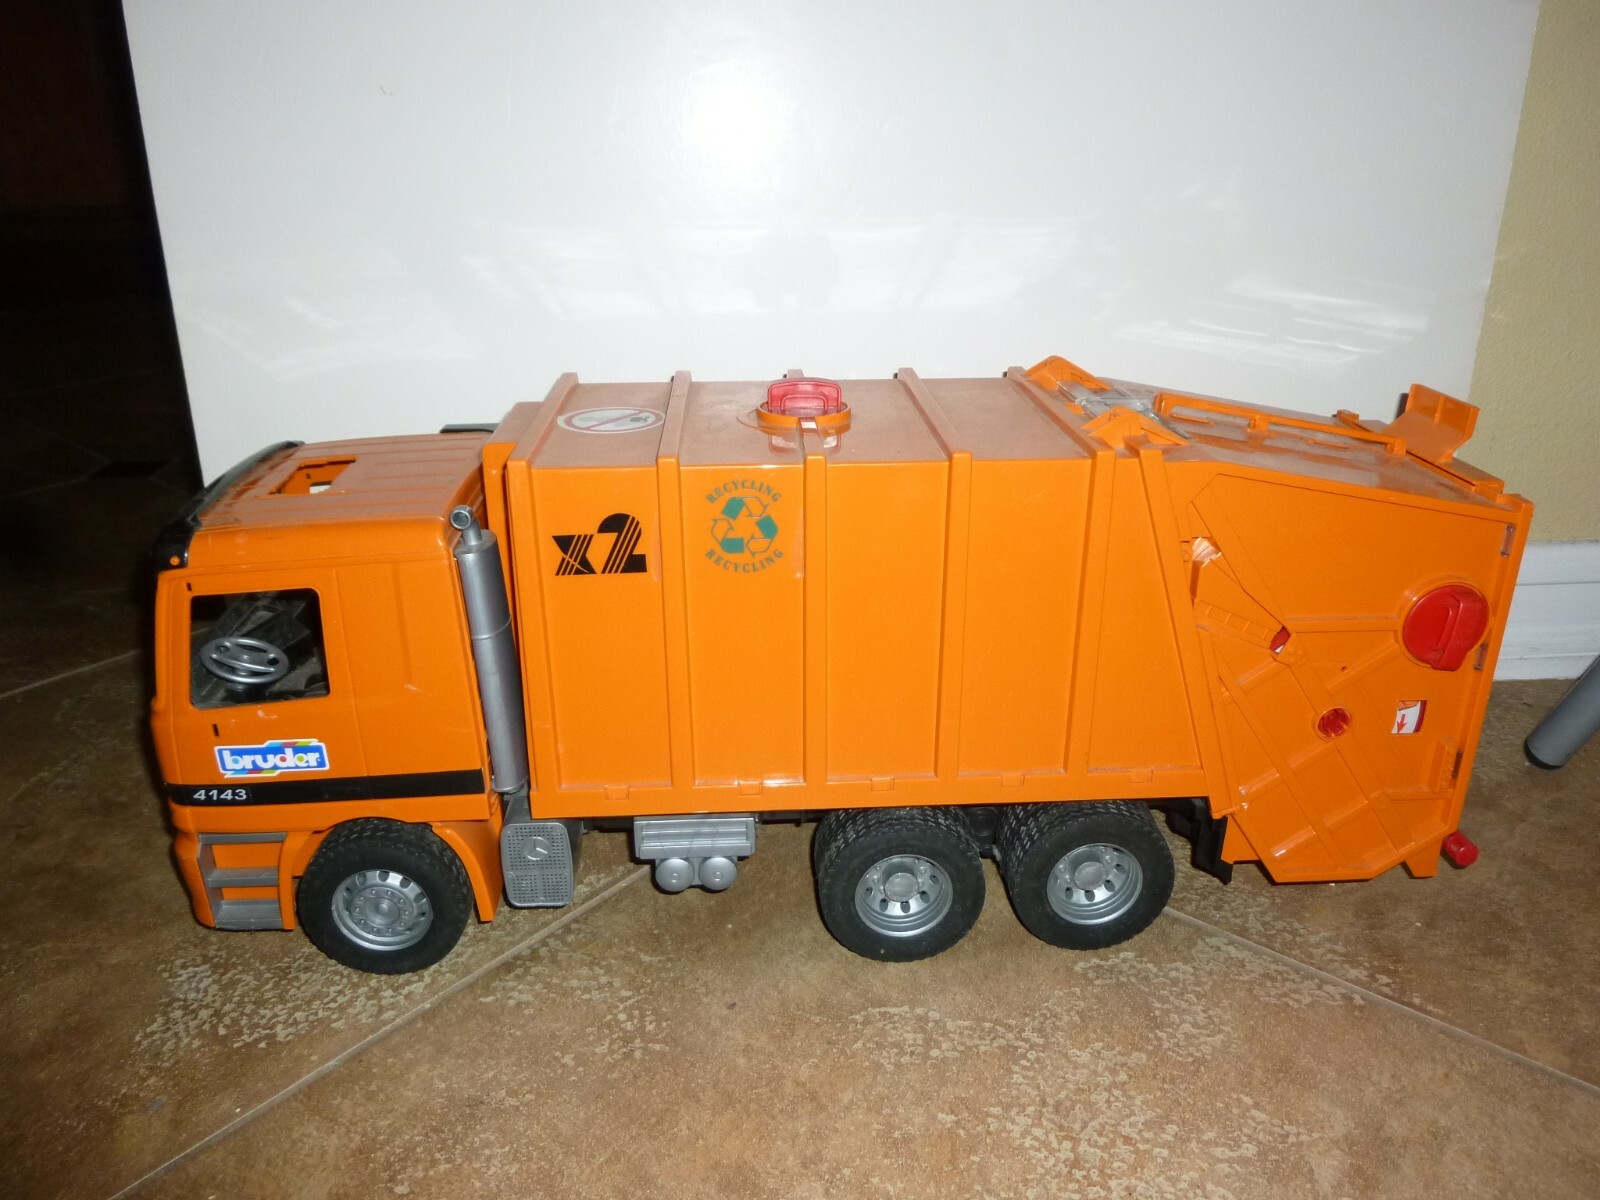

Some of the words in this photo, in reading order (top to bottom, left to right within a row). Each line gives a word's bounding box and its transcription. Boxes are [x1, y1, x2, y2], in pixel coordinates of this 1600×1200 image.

[706, 480, 781, 503] RECYCLING
[705, 549, 784, 573] RECYCLING
[223, 748, 320, 770] bruder
[193, 789, 247, 801] 4143
